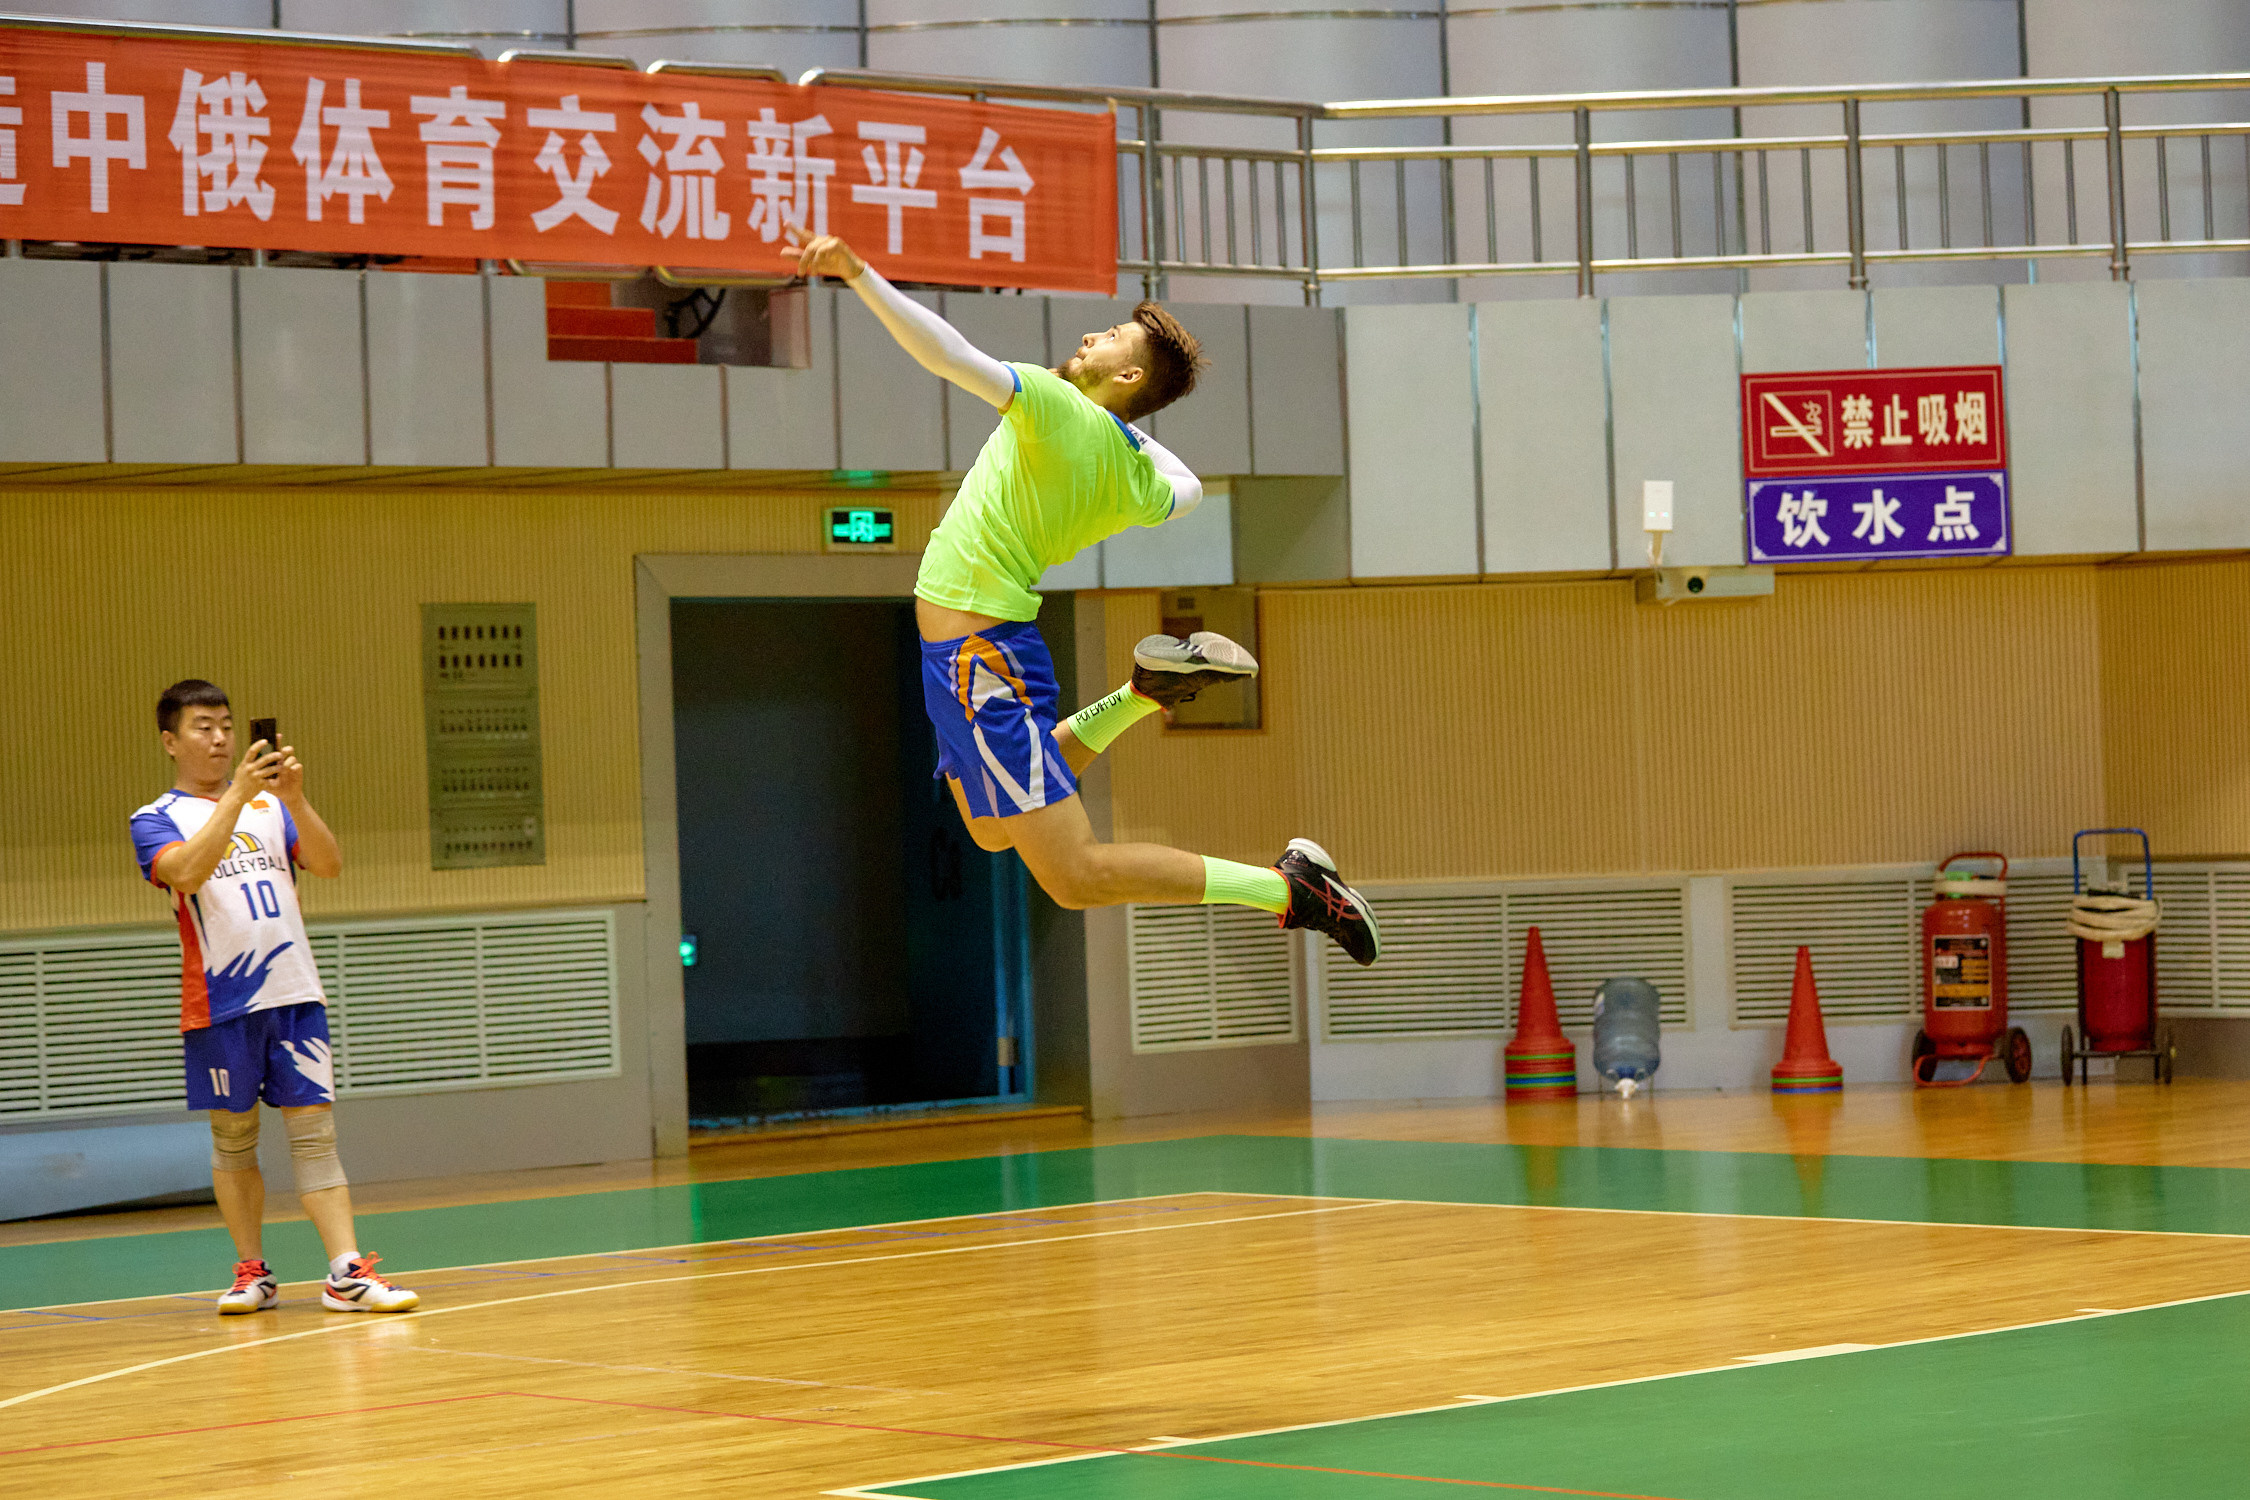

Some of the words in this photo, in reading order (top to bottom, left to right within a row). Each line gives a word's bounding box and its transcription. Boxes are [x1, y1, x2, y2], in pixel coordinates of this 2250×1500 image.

[1841, 391, 1988, 449] 禁止吸烟
[1776, 486, 1981, 547] 饮水点
[240, 880, 281, 921] 10
[208, 1067, 231, 1097] 10
